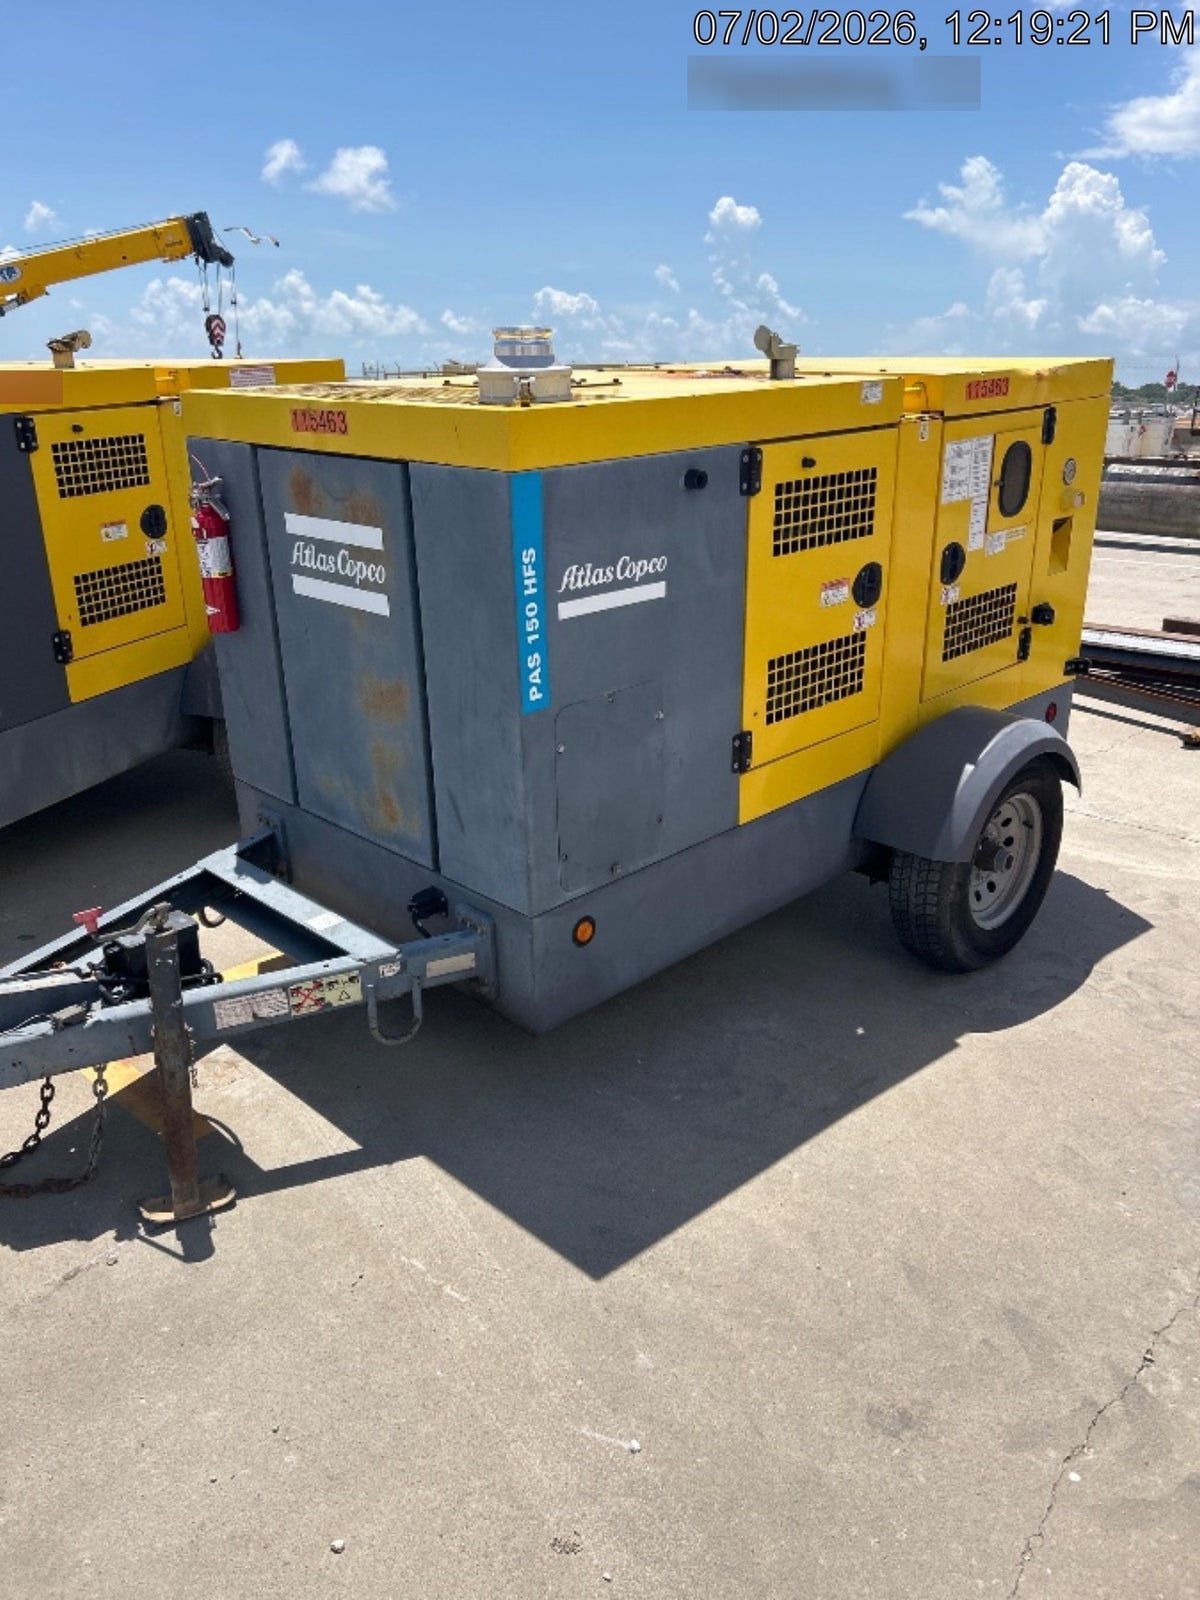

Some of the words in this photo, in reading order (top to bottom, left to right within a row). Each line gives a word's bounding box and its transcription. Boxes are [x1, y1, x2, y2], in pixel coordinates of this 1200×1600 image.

[292, 408, 347, 434] 115463
[290, 541, 335, 574] Atlas
[337, 549, 386, 585] Copco
[521, 547, 538, 595] HFS
[557, 562, 614, 593] Atlas
[616, 555, 667, 582] Copco
[525, 602, 540, 645] 150
[527, 652, 543, 701] PAS
